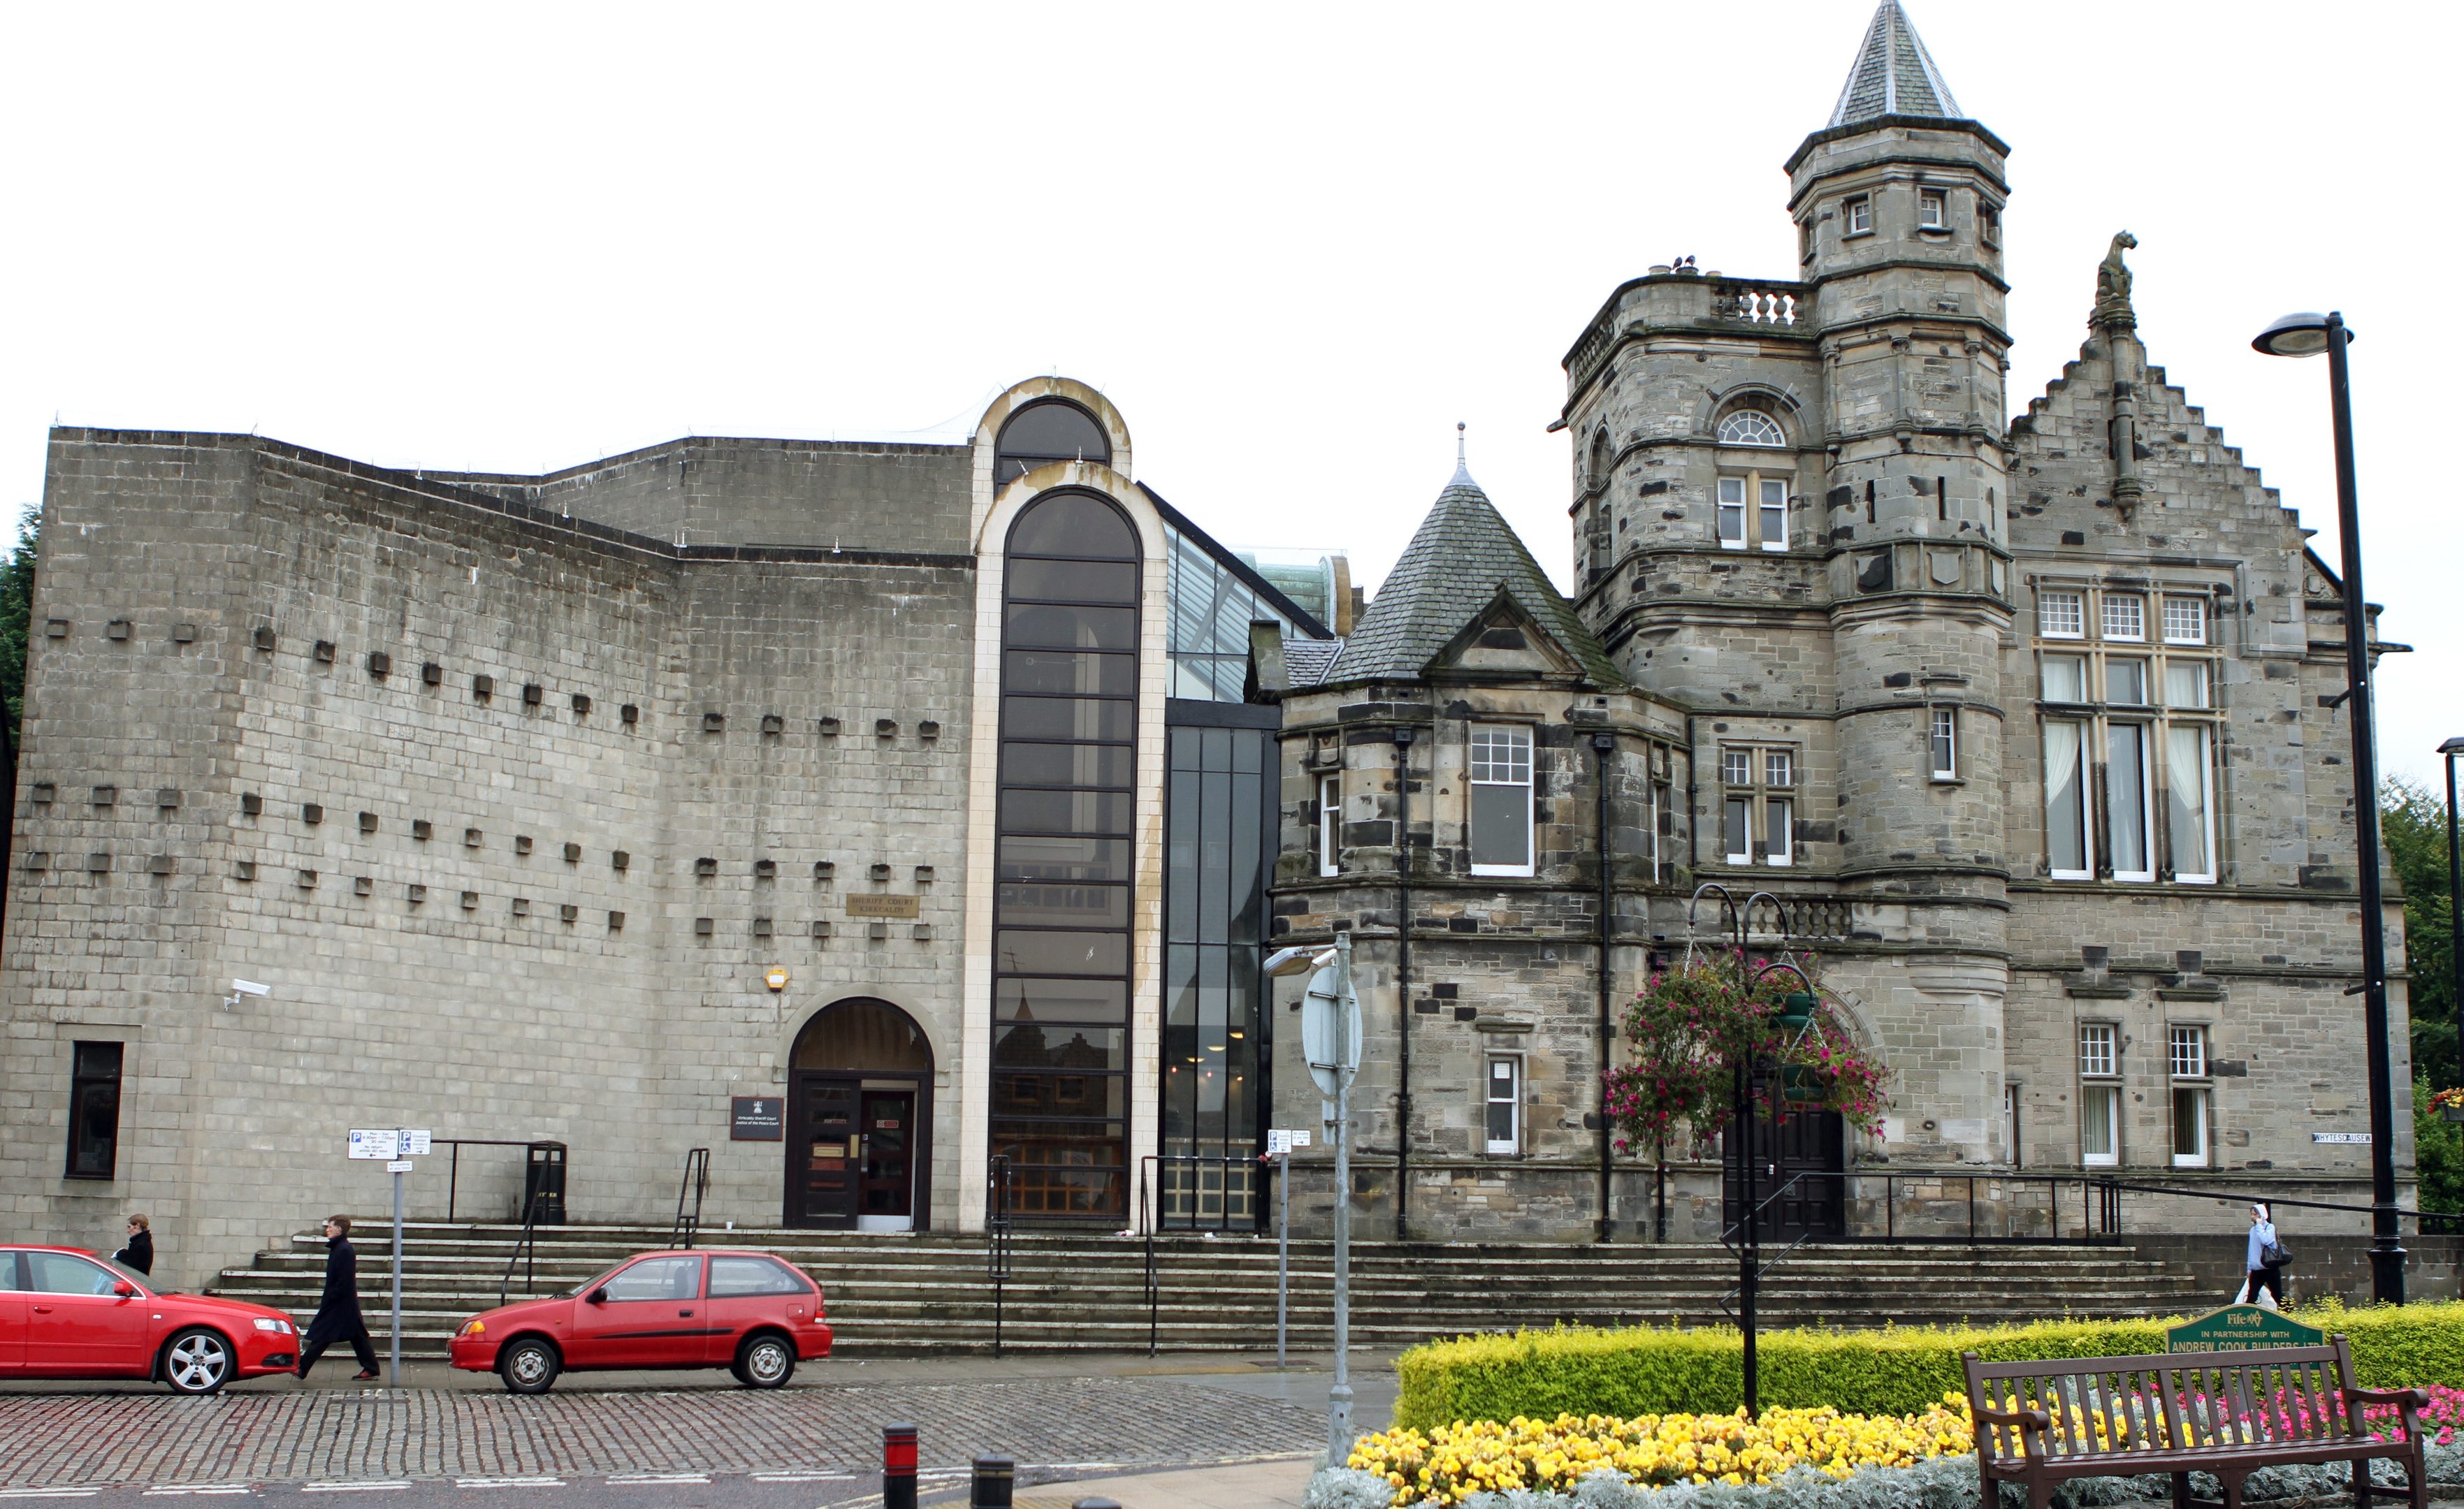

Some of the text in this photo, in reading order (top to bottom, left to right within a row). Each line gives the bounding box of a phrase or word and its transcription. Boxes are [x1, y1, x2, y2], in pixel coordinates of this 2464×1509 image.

[353, 1133, 360, 1142] P
[403, 1132, 410, 1141] P
[2226, 1313, 2247, 1325] Fife
[2172, 1341, 2214, 1353] ANDREW
[2219, 1341, 2247, 1352] COOK
